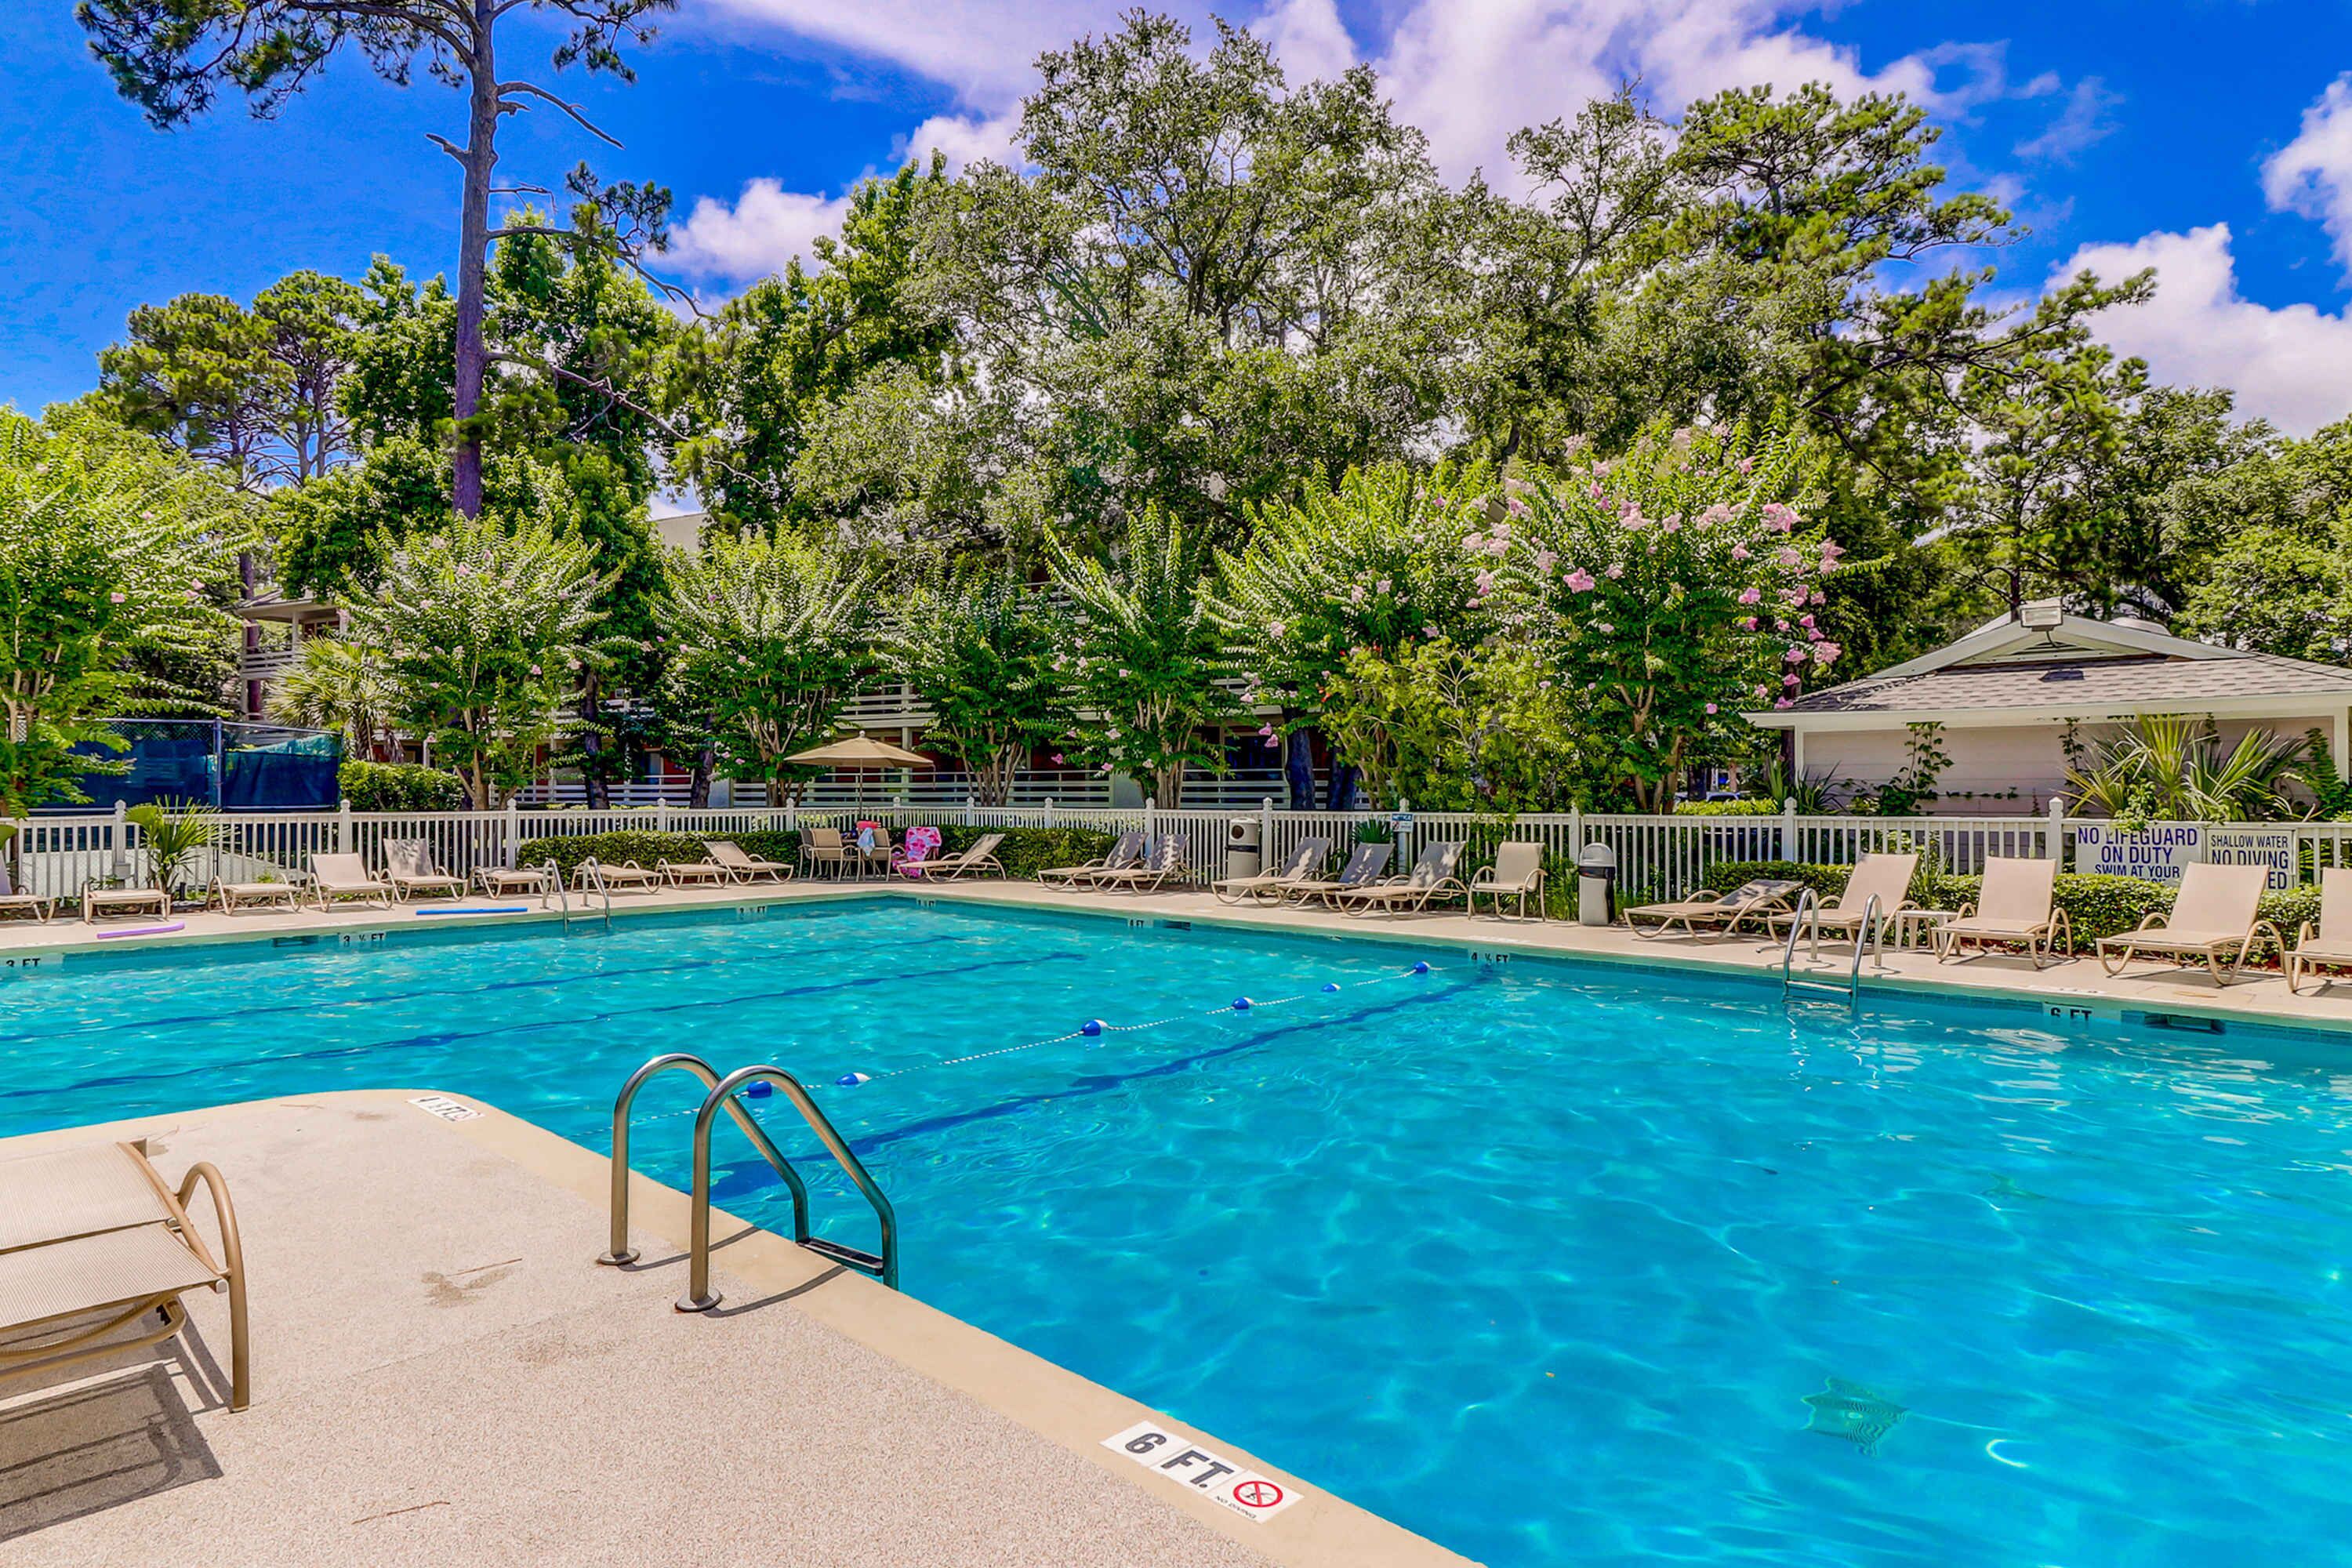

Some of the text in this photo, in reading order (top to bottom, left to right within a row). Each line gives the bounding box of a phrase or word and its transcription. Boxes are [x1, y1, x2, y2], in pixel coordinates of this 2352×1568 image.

[2078, 827, 2198, 845] NO LIFEGUARD
[2211, 835, 2288, 848] SHALLOW WATER
[2101, 846, 2173, 864] ON DUTY
[2212, 849, 2288, 869] NO DIVING
[2095, 864, 2180, 877] SWIM AT YOUR
[22, 957, 41, 967] FT
[1496, 954, 1508, 964] FT
[2070, 1008, 2092, 1021] FT
[1124, 1432, 1236, 1488] 6 FT.
